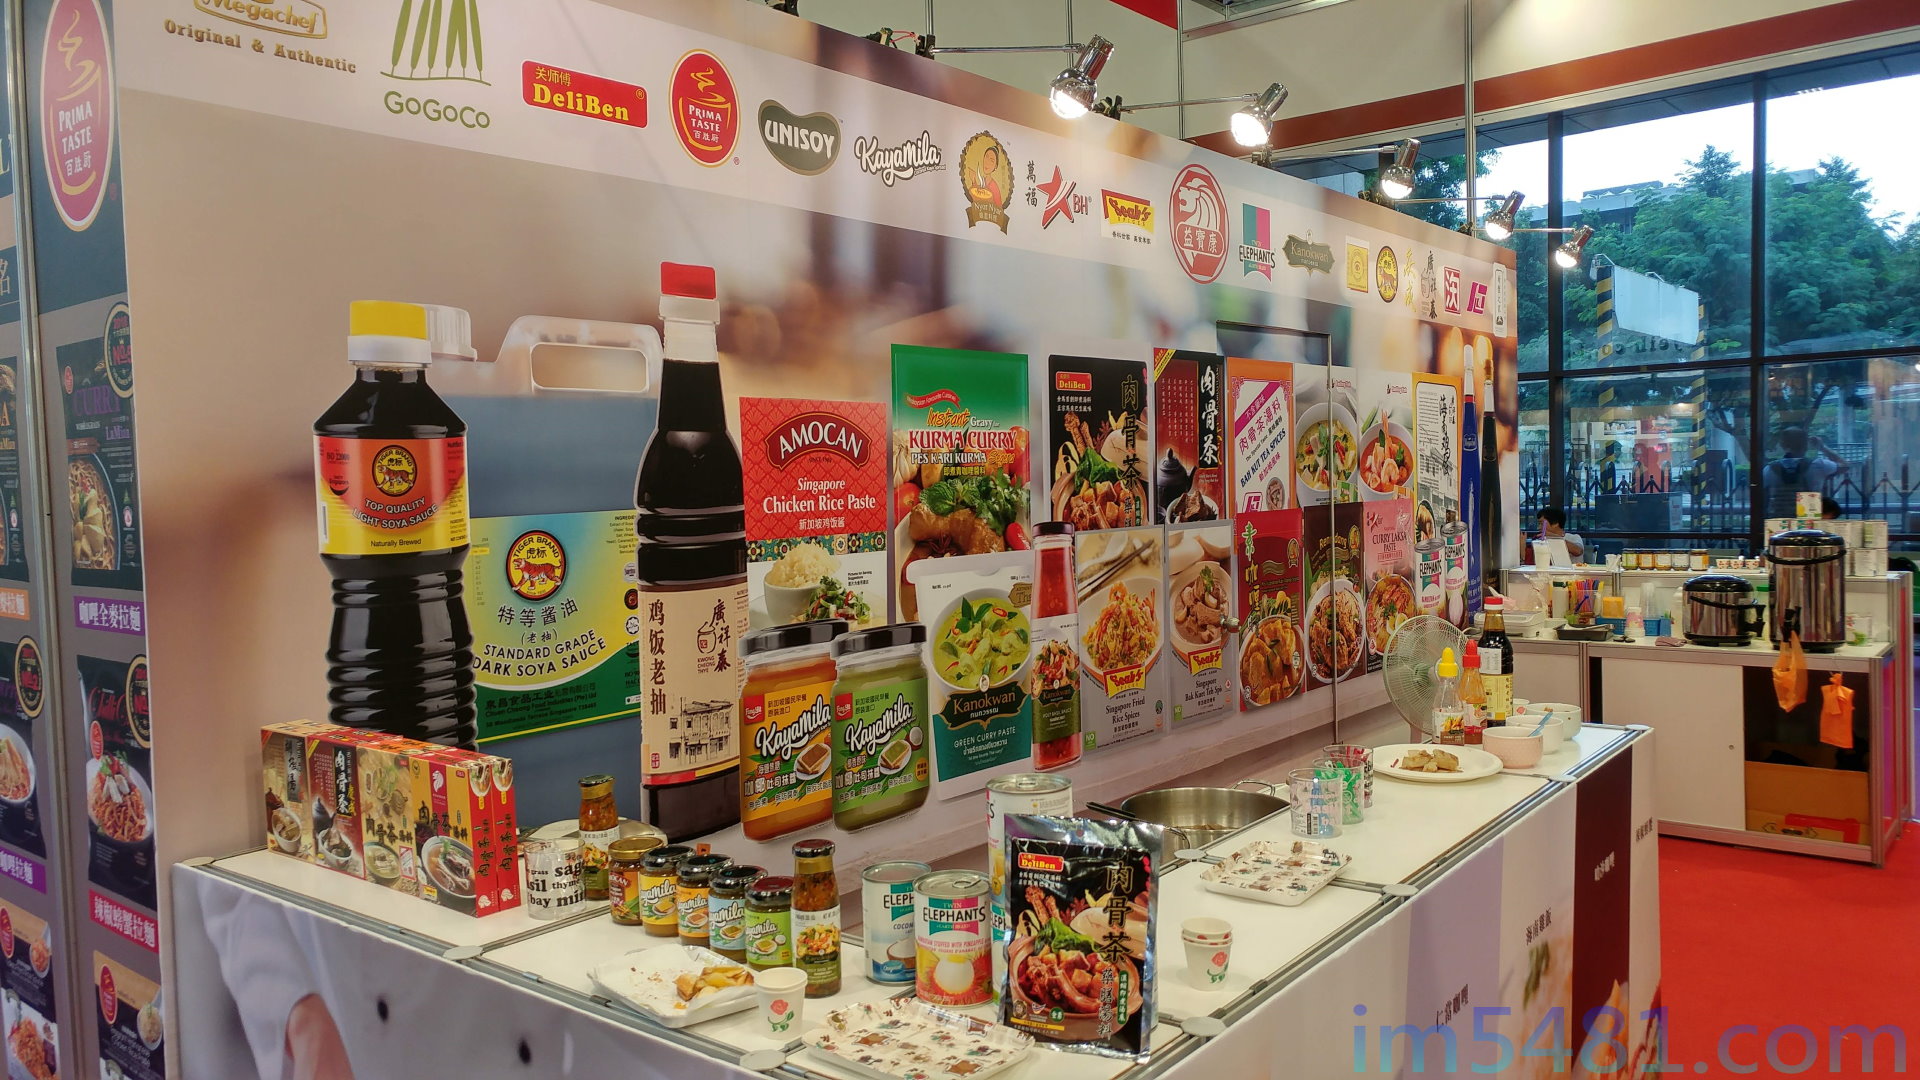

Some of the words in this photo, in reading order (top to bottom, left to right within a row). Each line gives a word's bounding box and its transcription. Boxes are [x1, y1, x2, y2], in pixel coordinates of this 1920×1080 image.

[164, 18, 242, 48] Original
[251, 38, 264, 53] &
[273, 43, 357, 73] Authentic
[535, 66, 571, 87] 关师傅
[383, 90, 491, 129] GoGoCo
[533, 82, 630, 121] DeliBen
[58, 101, 93, 133] PRIMA
[688, 104, 722, 122] PRIMA
[691, 118, 721, 132] TASTE
[61, 129, 93, 155] TASTE
[765, 119, 835, 159] UNISOY
[854, 130, 942, 188] Kayamila
[1073, 194, 1089, 215] BH
[1108, 198, 1152, 222] Seah's
[1239, 245, 1276, 269] ELEPHANTS
[1291, 242, 1329, 263] Kanokwan
[1059, 380, 1086, 389] DeliBen
[927, 407, 971, 428] Instant
[971, 416, 993, 430] Gravy
[1200, 365, 1218, 465] 肉骨茶
[779, 421, 862, 460] AMOCAN
[908, 430, 965, 450] KURMA
[967, 430, 1017, 450] CURRY
[1120, 374, 1142, 490] 肉骨茶
[1260, 448, 1271, 462] TEA
[1269, 427, 1287, 452] SPICES
[911, 452, 929, 464] PES
[931, 452, 953, 464] KARI
[955, 451, 987, 464] KURMA
[797, 477, 845, 494] Singapore
[364, 498, 384, 512] TOP
[385, 496, 426, 514] QUALITY
[763, 495, 815, 514] Chicken
[818, 494, 845, 510] Rice
[848, 494, 876, 510] Paste
[352, 508, 379, 528] LIGHT
[381, 520, 408, 529] SOYA
[409, 503, 440, 526] SAUCE
[370, 538, 398, 548] Naturally
[399, 537, 422, 546] Brewed
[512, 536, 535, 558] TIGER
[536, 536, 560, 558] BRAND
[1372, 533, 1391, 544] CURRY
[1391, 531, 1408, 542] LAKSA
[1383, 543, 1397, 552] PASTE
[526, 546, 547, 560] 虎标
[1445, 543, 1466, 561] ELEPHANTS
[1420, 560, 1443, 578] ELEPHANTS
[484, 644, 550, 660] STANDARD
[555, 629, 596, 654] GRADE
[711, 598, 731, 673] 廣祥泰
[472, 657, 511, 677] DARK
[517, 662, 556, 677] SOYA
[562, 637, 606, 669] SAUCE
[648, 598, 666, 716] 鸡饭老抽
[697, 661, 716, 669] CHEONG
[1193, 650, 1222, 666] Seah's
[1110, 669, 1144, 688] Seah's
[1195, 678, 1217, 690] Singapore
[953, 691, 1016, 715] Kanokwan
[1105, 701, 1132, 715] Singapore
[1132, 696, 1146, 707] Fried
[755, 695, 832, 761] Kayamila
[844, 693, 913, 756] Kayamila
[1112, 714, 1124, 725] Rice
[1124, 710, 1140, 723] Spices
[954, 736, 975, 748] GREEN
[976, 731, 997, 744] CURRY
[998, 726, 1016, 738] PASTE
[1085, 732, 1096, 741] NO
[335, 750, 349, 814] 肉骨茶
[1022, 859, 1055, 869] DeliBen
[527, 879, 548, 892] sil
[530, 893, 551, 908] bay
[923, 906, 986, 922] ELEPHANTS
[1100, 861, 1134, 964] 肉骨茶
